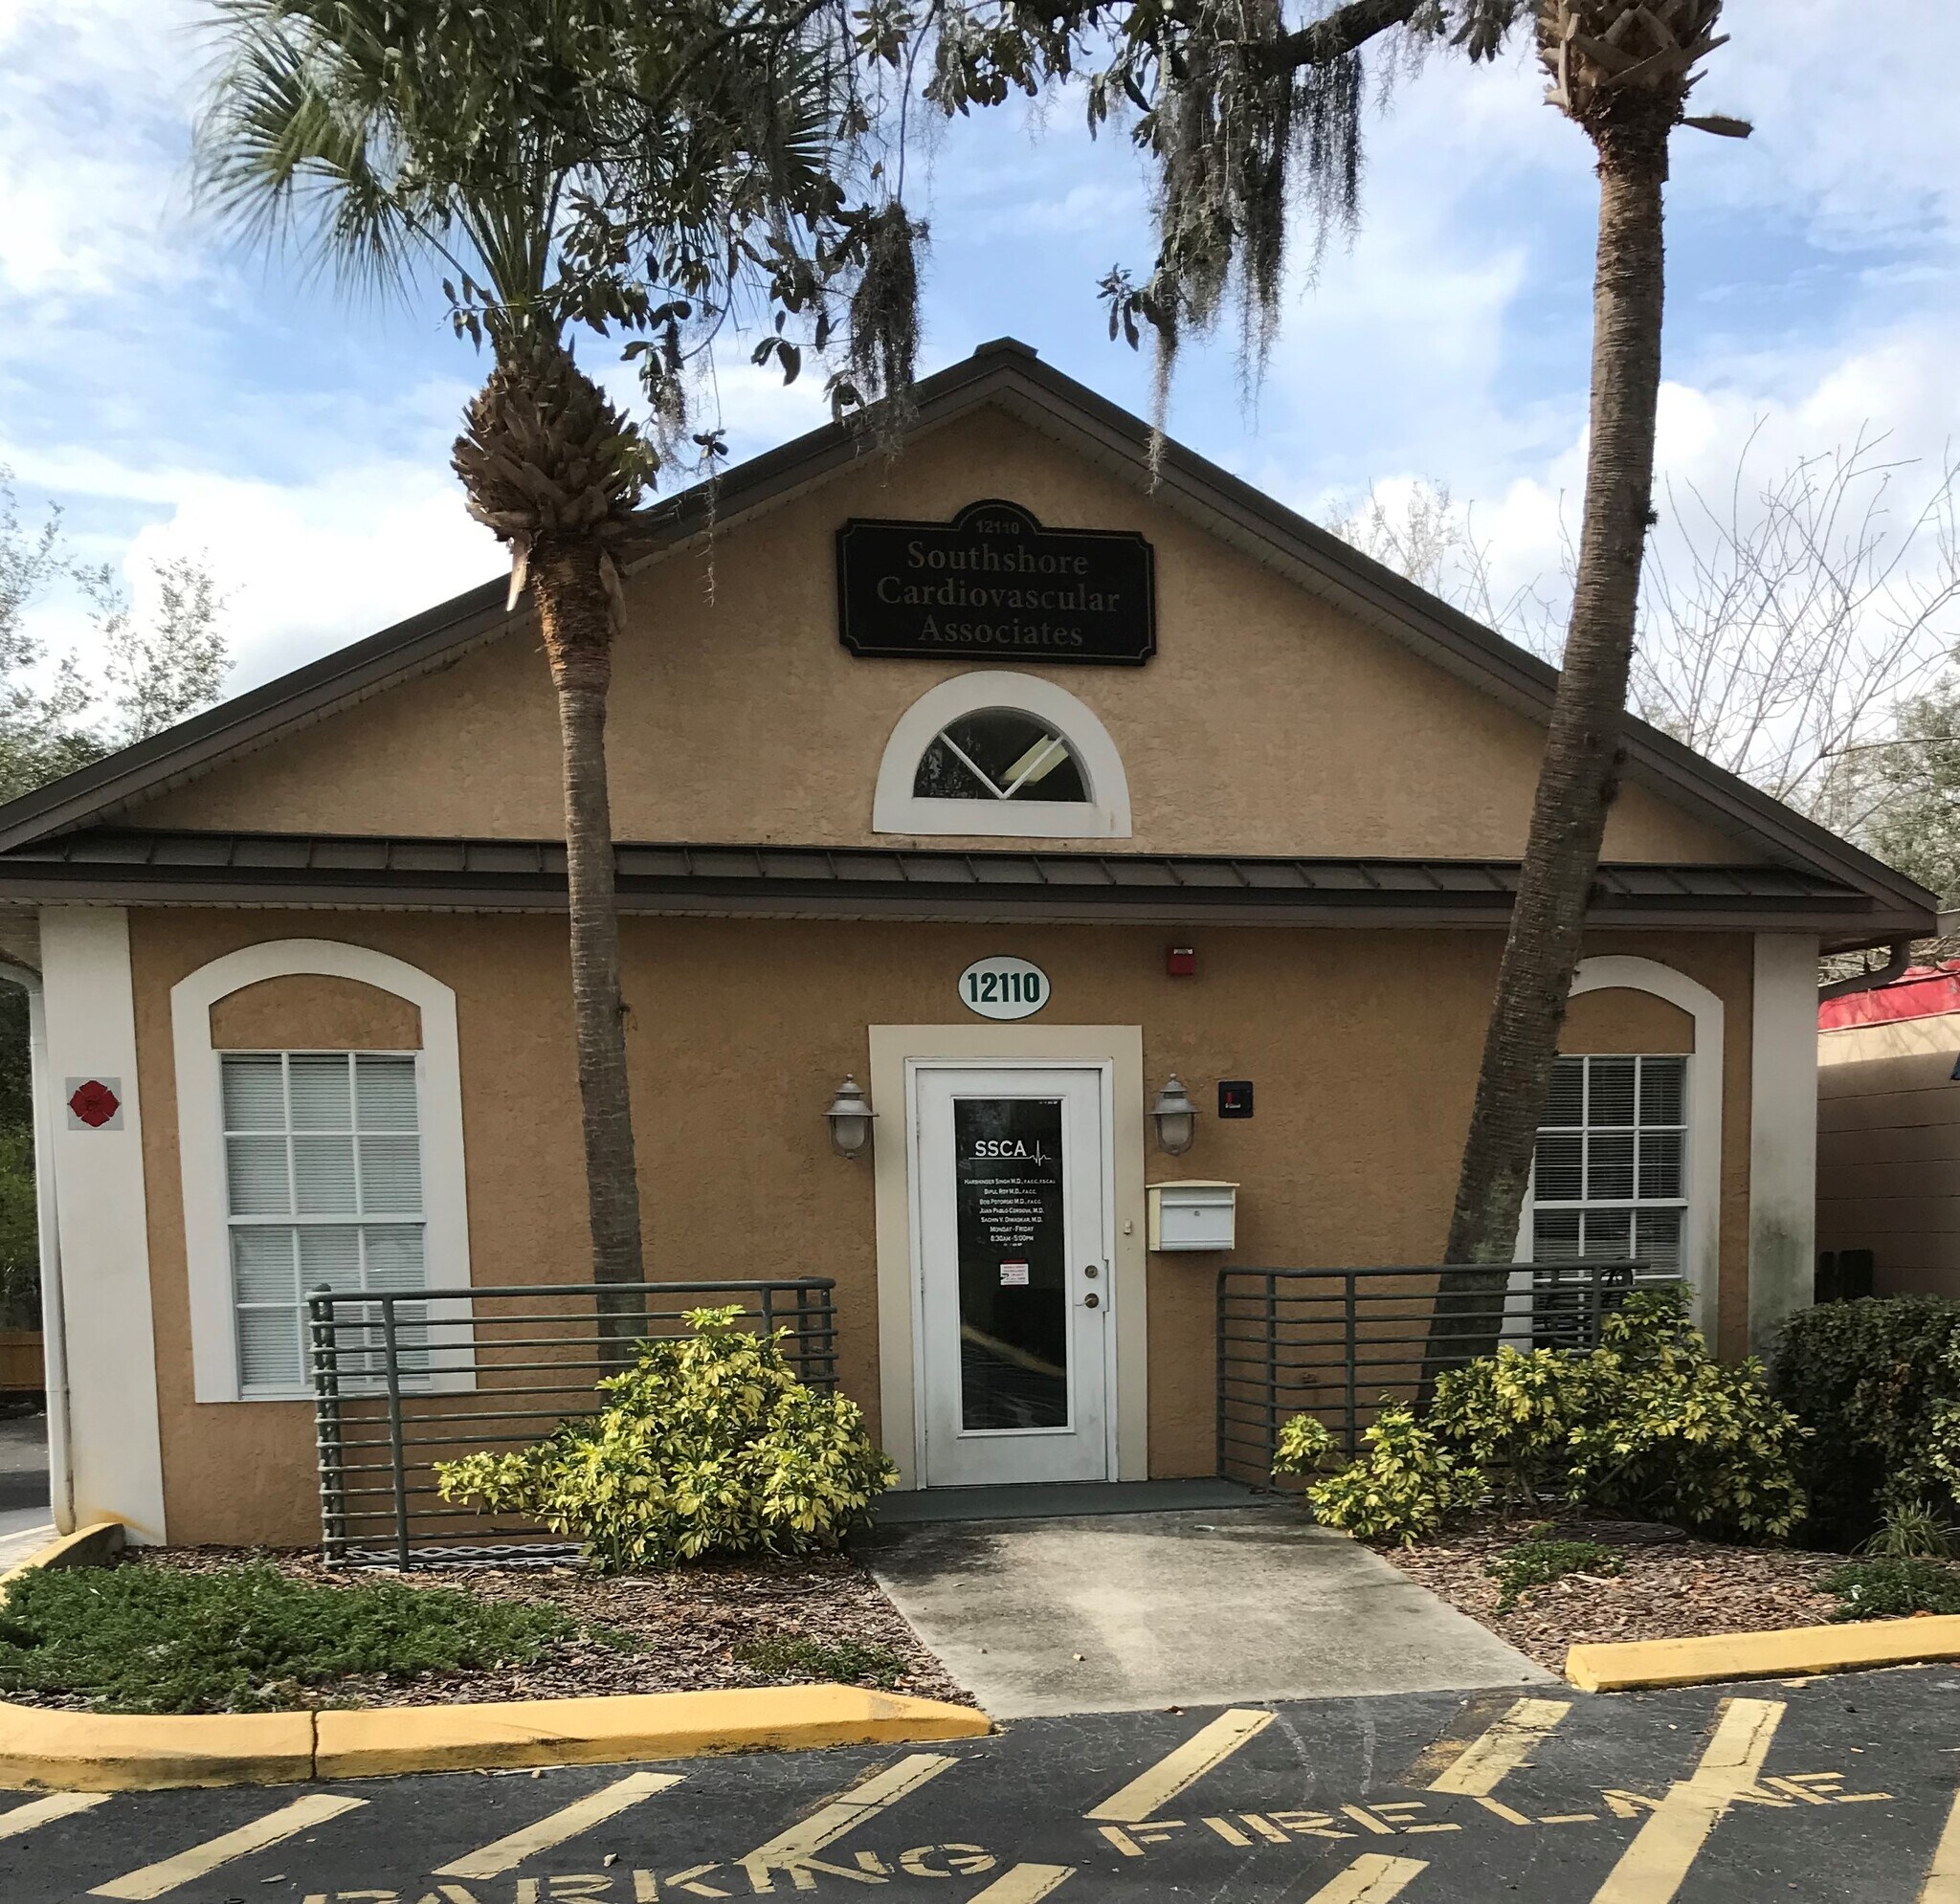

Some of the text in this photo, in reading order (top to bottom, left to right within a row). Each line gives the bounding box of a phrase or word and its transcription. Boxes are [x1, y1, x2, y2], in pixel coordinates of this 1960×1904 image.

[976, 520, 1020, 535] 12110
[907, 540, 1089, 575] Southshore
[877, 576, 1121, 613] Cardiovascular
[918, 613, 1083, 647] Associates
[968, 971, 1040, 1003] 12110
[975, 1140, 1027, 1157] SSCA
[1098, 1801, 1463, 1856] FIRE
